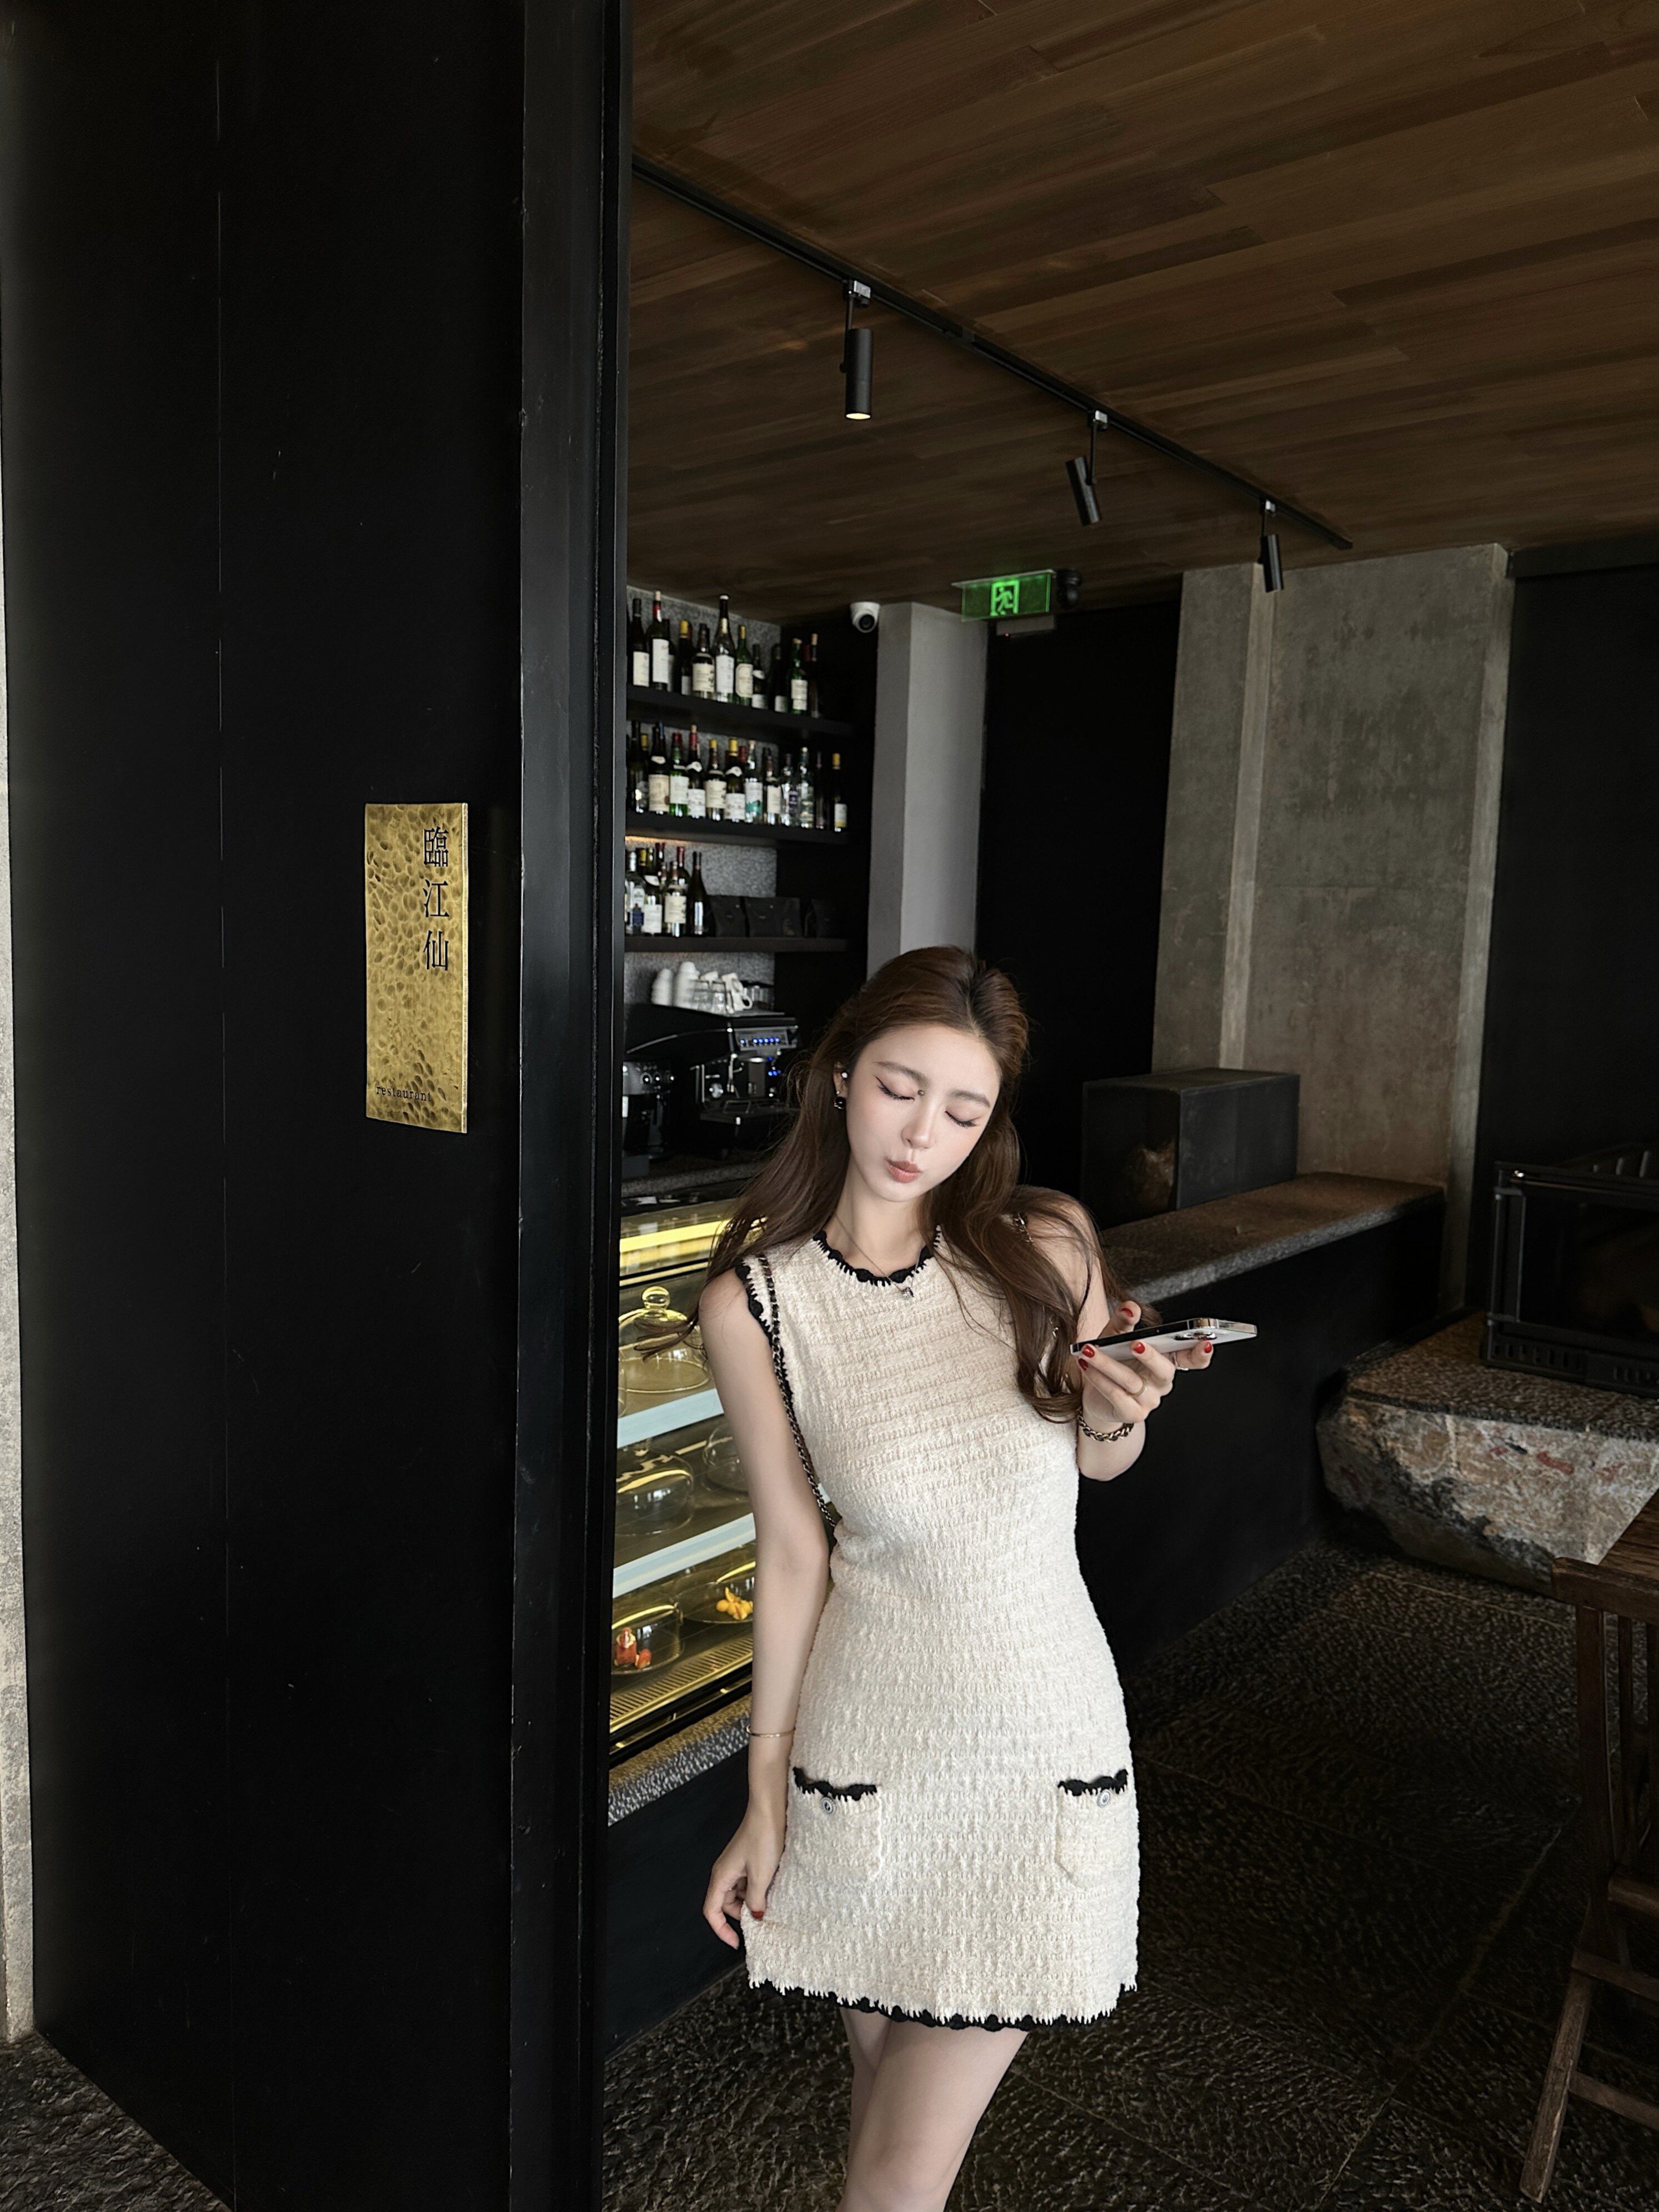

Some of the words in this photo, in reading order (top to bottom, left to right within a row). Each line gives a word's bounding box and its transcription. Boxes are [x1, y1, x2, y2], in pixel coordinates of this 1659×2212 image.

[423, 826, 449, 971] 臨江仙
[376, 1085, 432, 1102] restaurant
